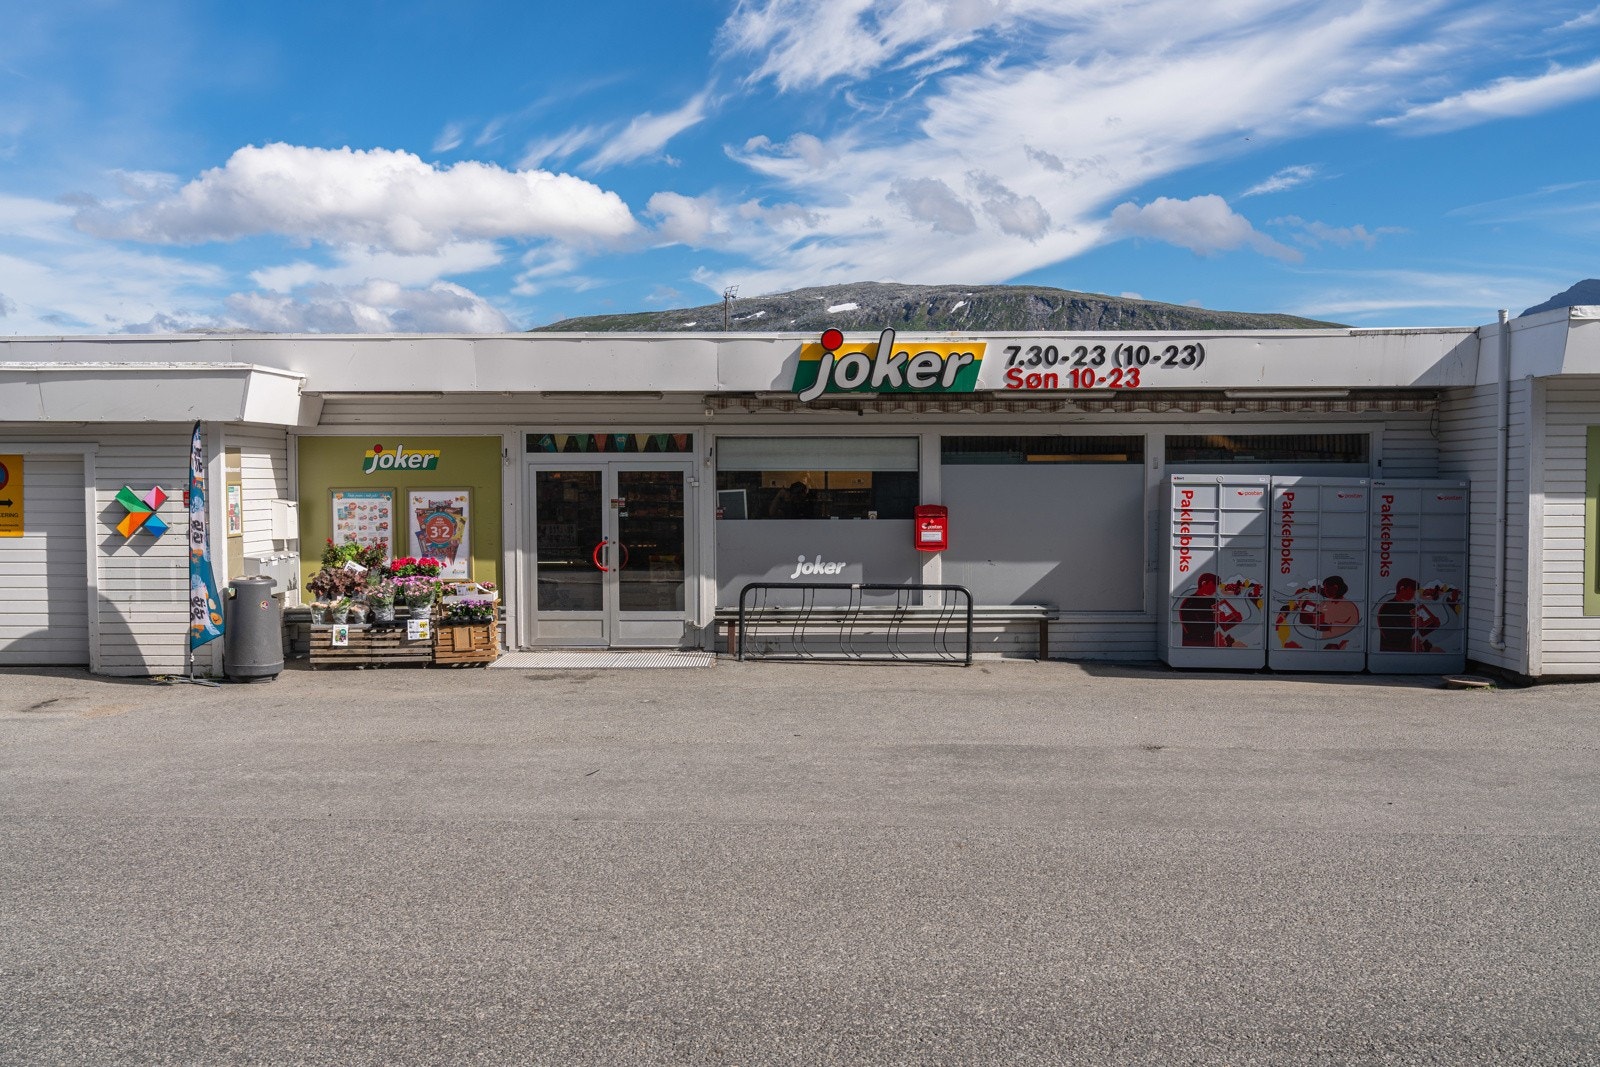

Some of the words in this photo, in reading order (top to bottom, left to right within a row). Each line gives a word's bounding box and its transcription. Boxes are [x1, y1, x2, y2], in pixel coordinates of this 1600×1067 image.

[798, 327, 974, 403] joker
[1006, 345, 1106, 367] 7.30-23
[1114, 343, 1205, 370] (10-23)
[1006, 367, 1058, 389] Søn
[1070, 367, 1141, 389] 10-23
[364, 444, 435, 475] joker
[1179, 490, 1194, 573] Pakkeboks
[1281, 491, 1295, 574] Pakkeboks
[1380, 495, 1394, 577] Pakkeboks
[790, 554, 846, 579] joker
